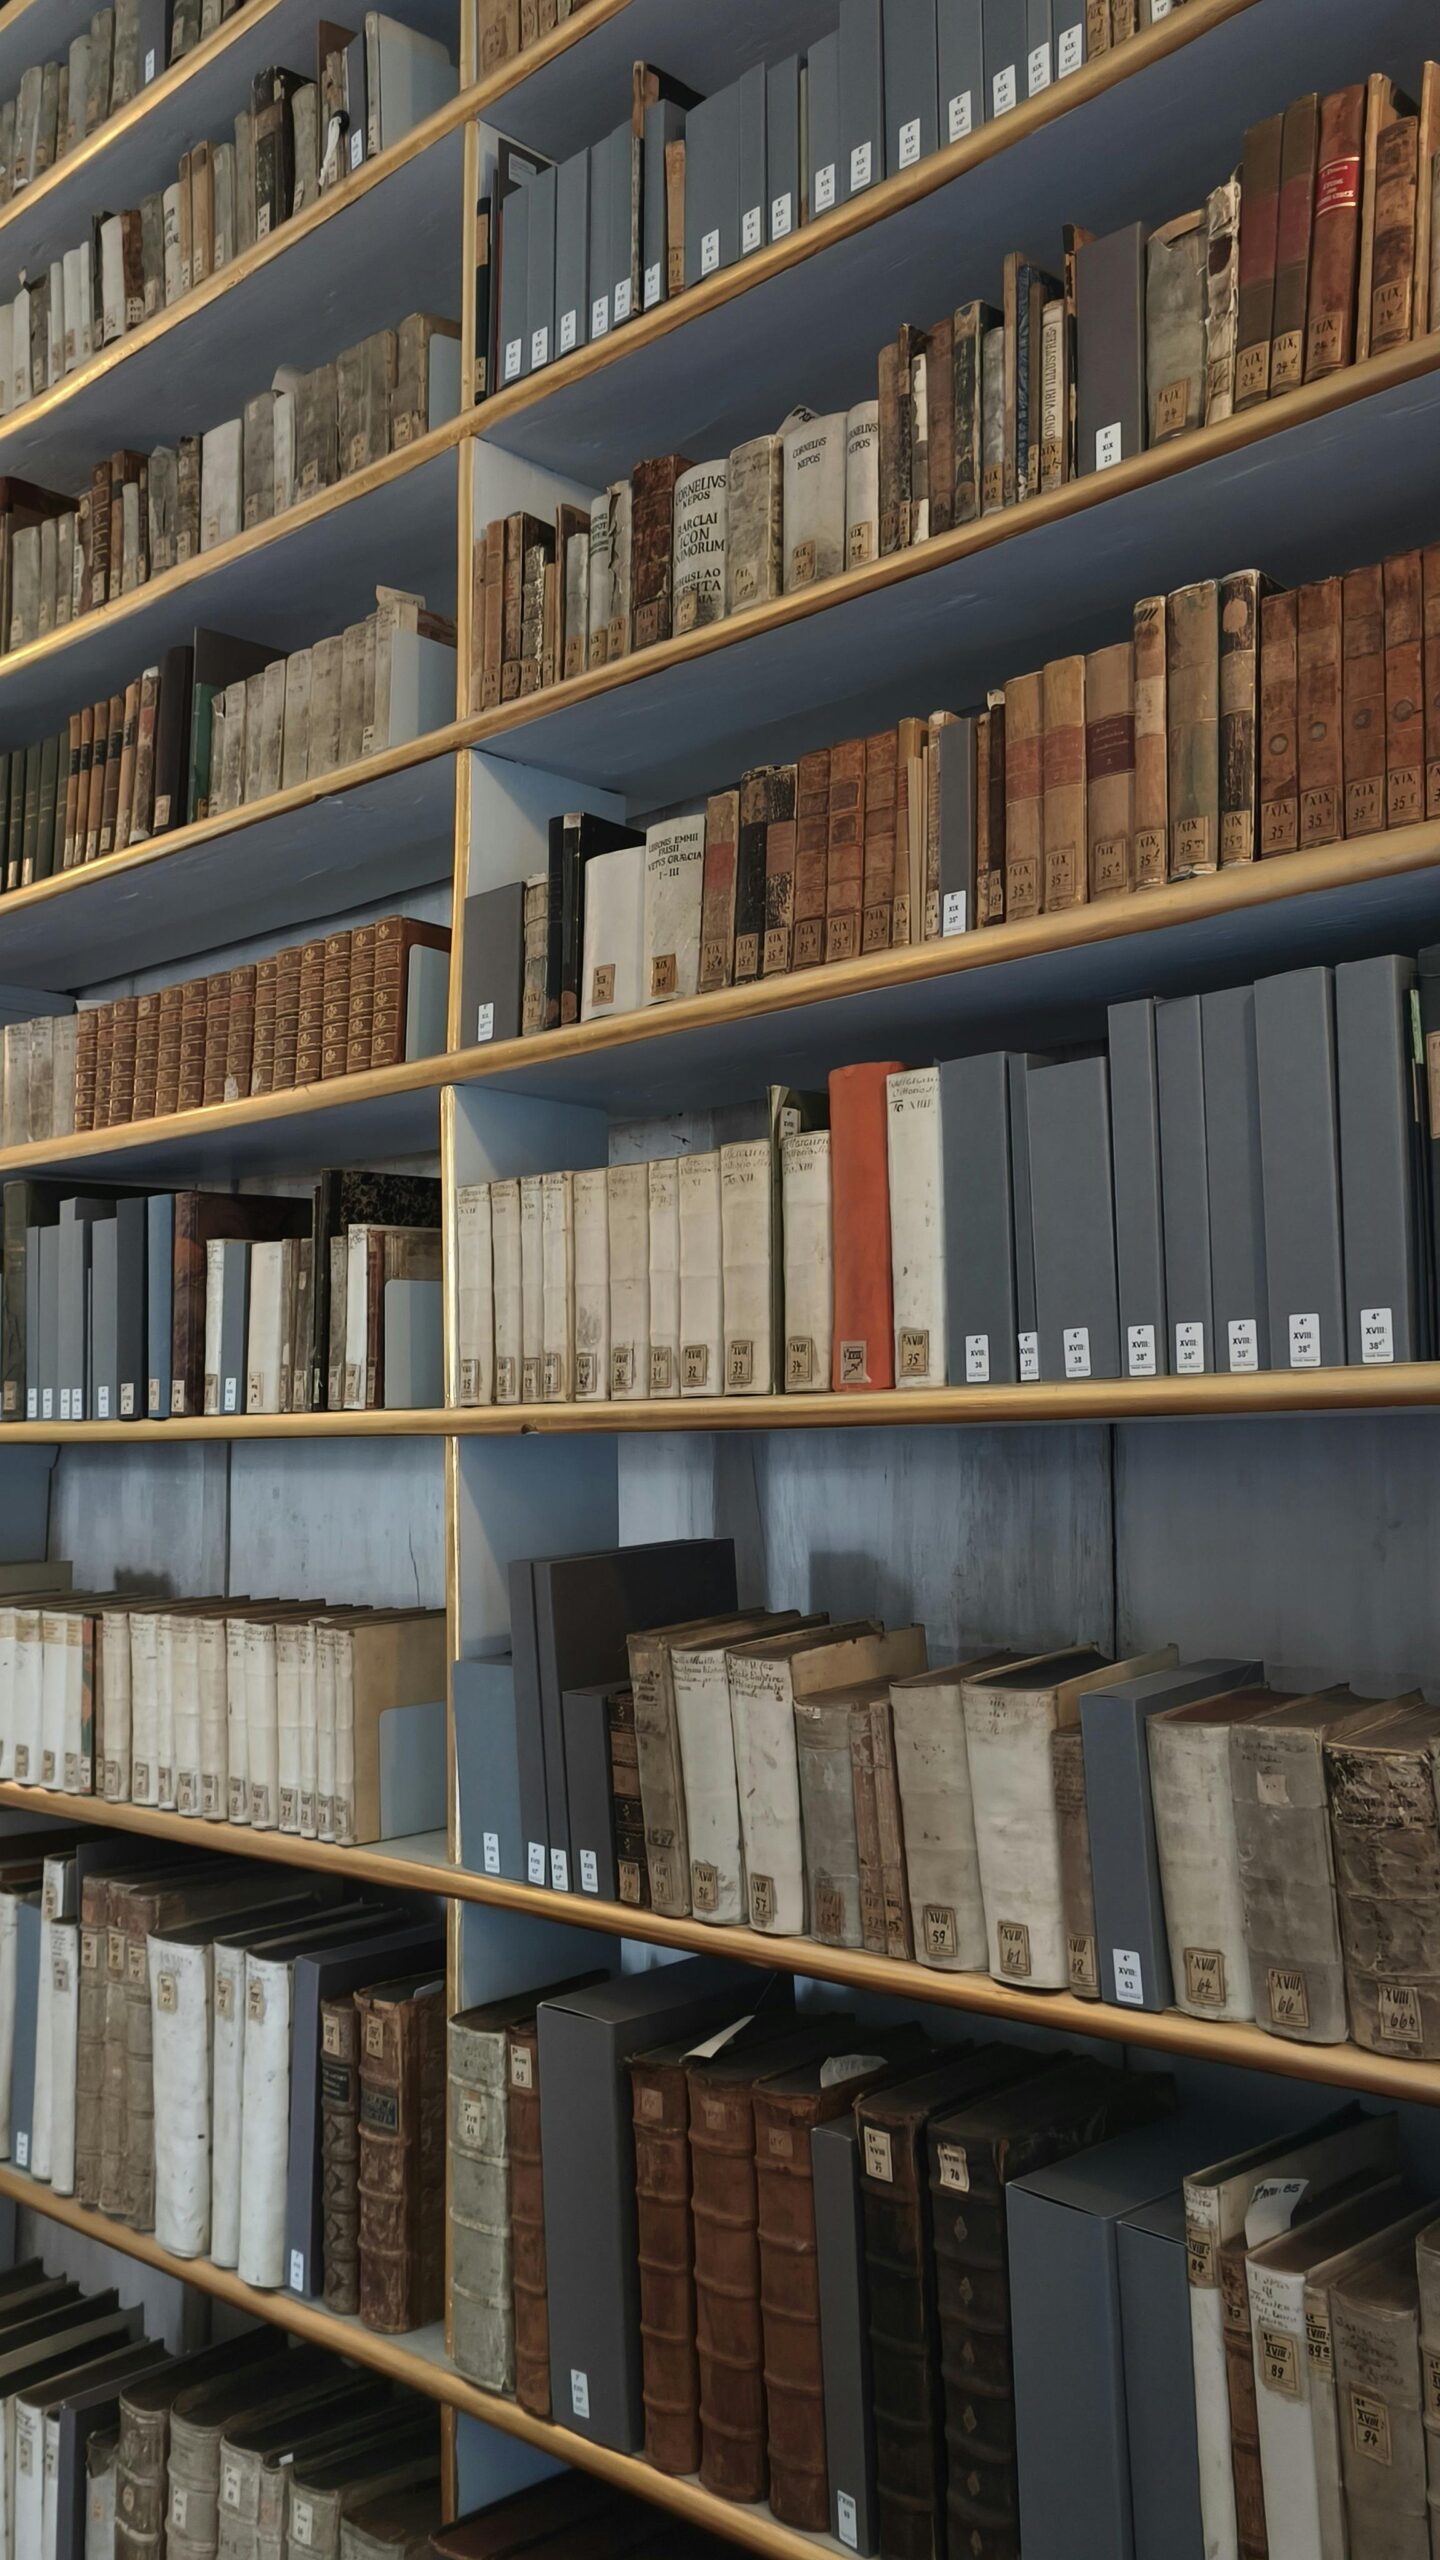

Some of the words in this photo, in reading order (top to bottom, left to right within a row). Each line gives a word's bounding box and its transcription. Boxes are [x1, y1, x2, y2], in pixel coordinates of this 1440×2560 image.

[797, 453, 820, 470] NEPOS
[676, 475, 726, 506] CORNELIVS
[683, 490, 710, 510] NEPOS
[678, 512, 718, 537] BARCLAI
[680, 527, 709, 549] ICON
[674, 833, 698, 844] EMMII
[659, 845, 679, 857] FRISII
[734, 1362, 742, 1374] 33
[932, 1930, 945, 1944] 59
[1284, 2183, 1300, 2193] 85
[1271, 2365, 1284, 2378] 89
[1363, 2431, 1377, 2446] 94
